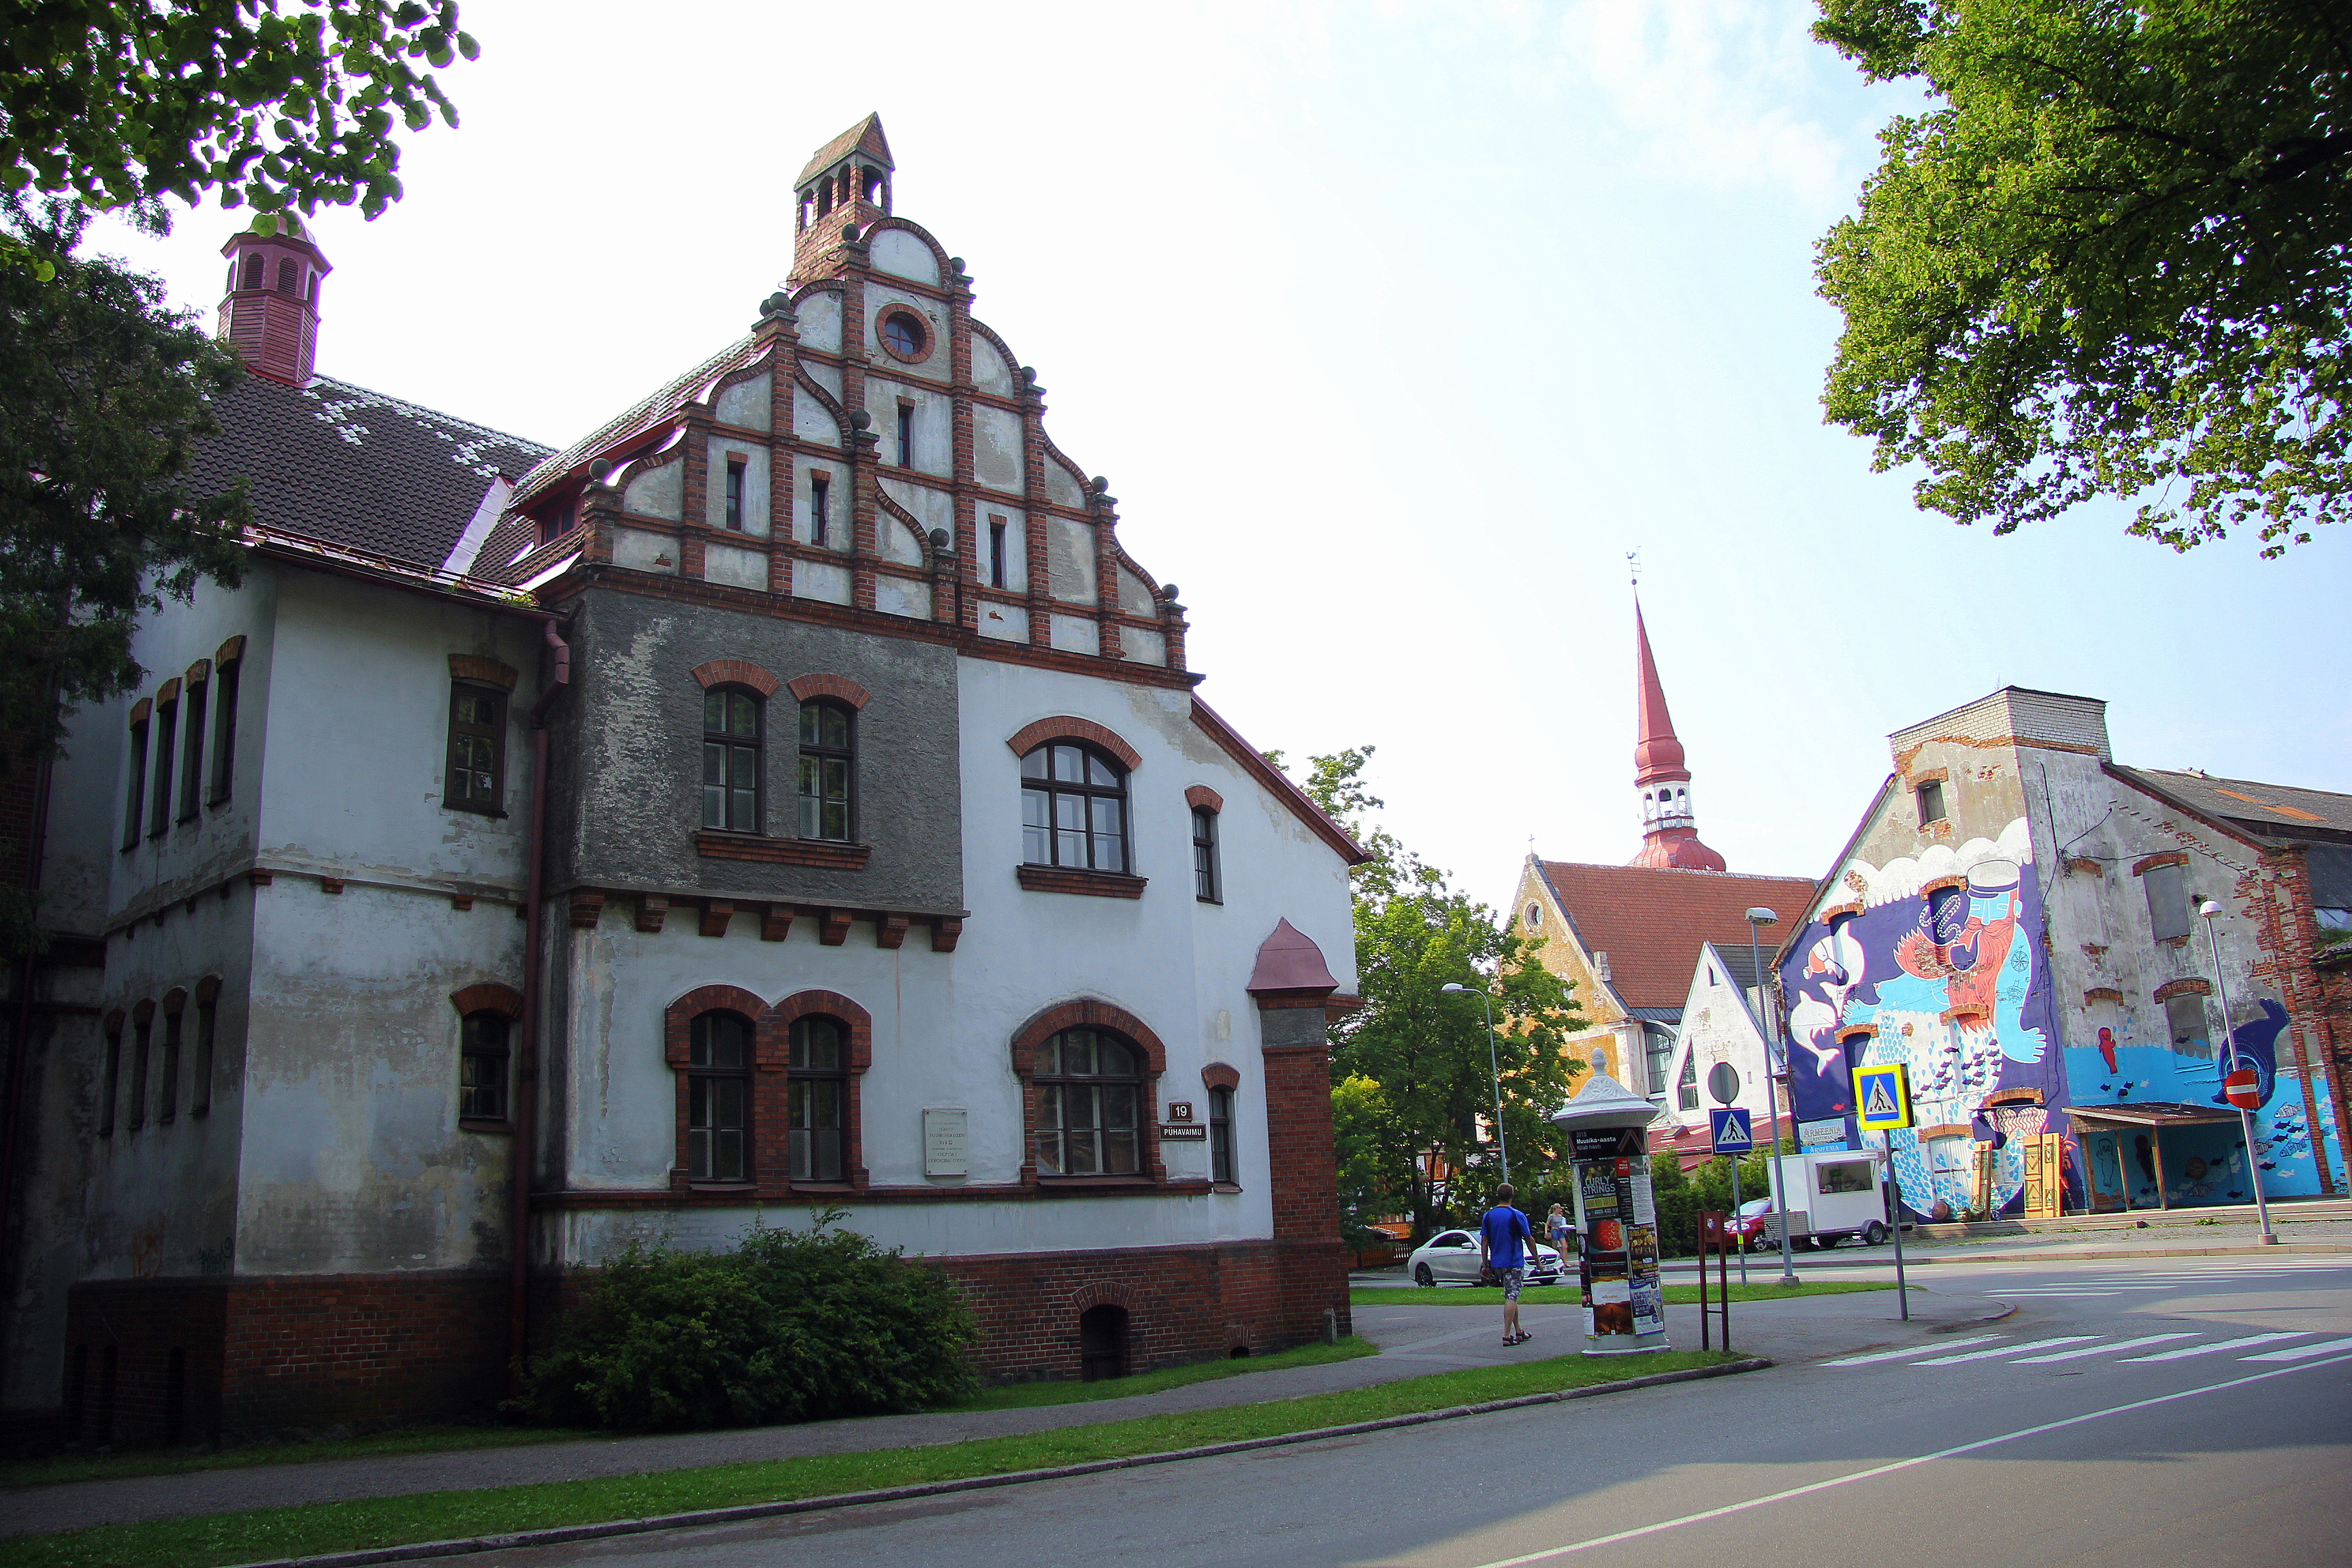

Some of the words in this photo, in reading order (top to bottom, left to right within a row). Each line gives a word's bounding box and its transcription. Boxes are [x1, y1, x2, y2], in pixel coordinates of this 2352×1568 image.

[1175, 1106, 1187, 1117] 19
[1164, 1126, 1202, 1136] PÜHAVAIMU
[1803, 1126, 1842, 1137] ARMEENIA
[1810, 1145, 1840, 1154] ARMEENIA
[1585, 1175, 1610, 1187] CURLY
[1582, 1183, 1616, 1195] STRINGS
